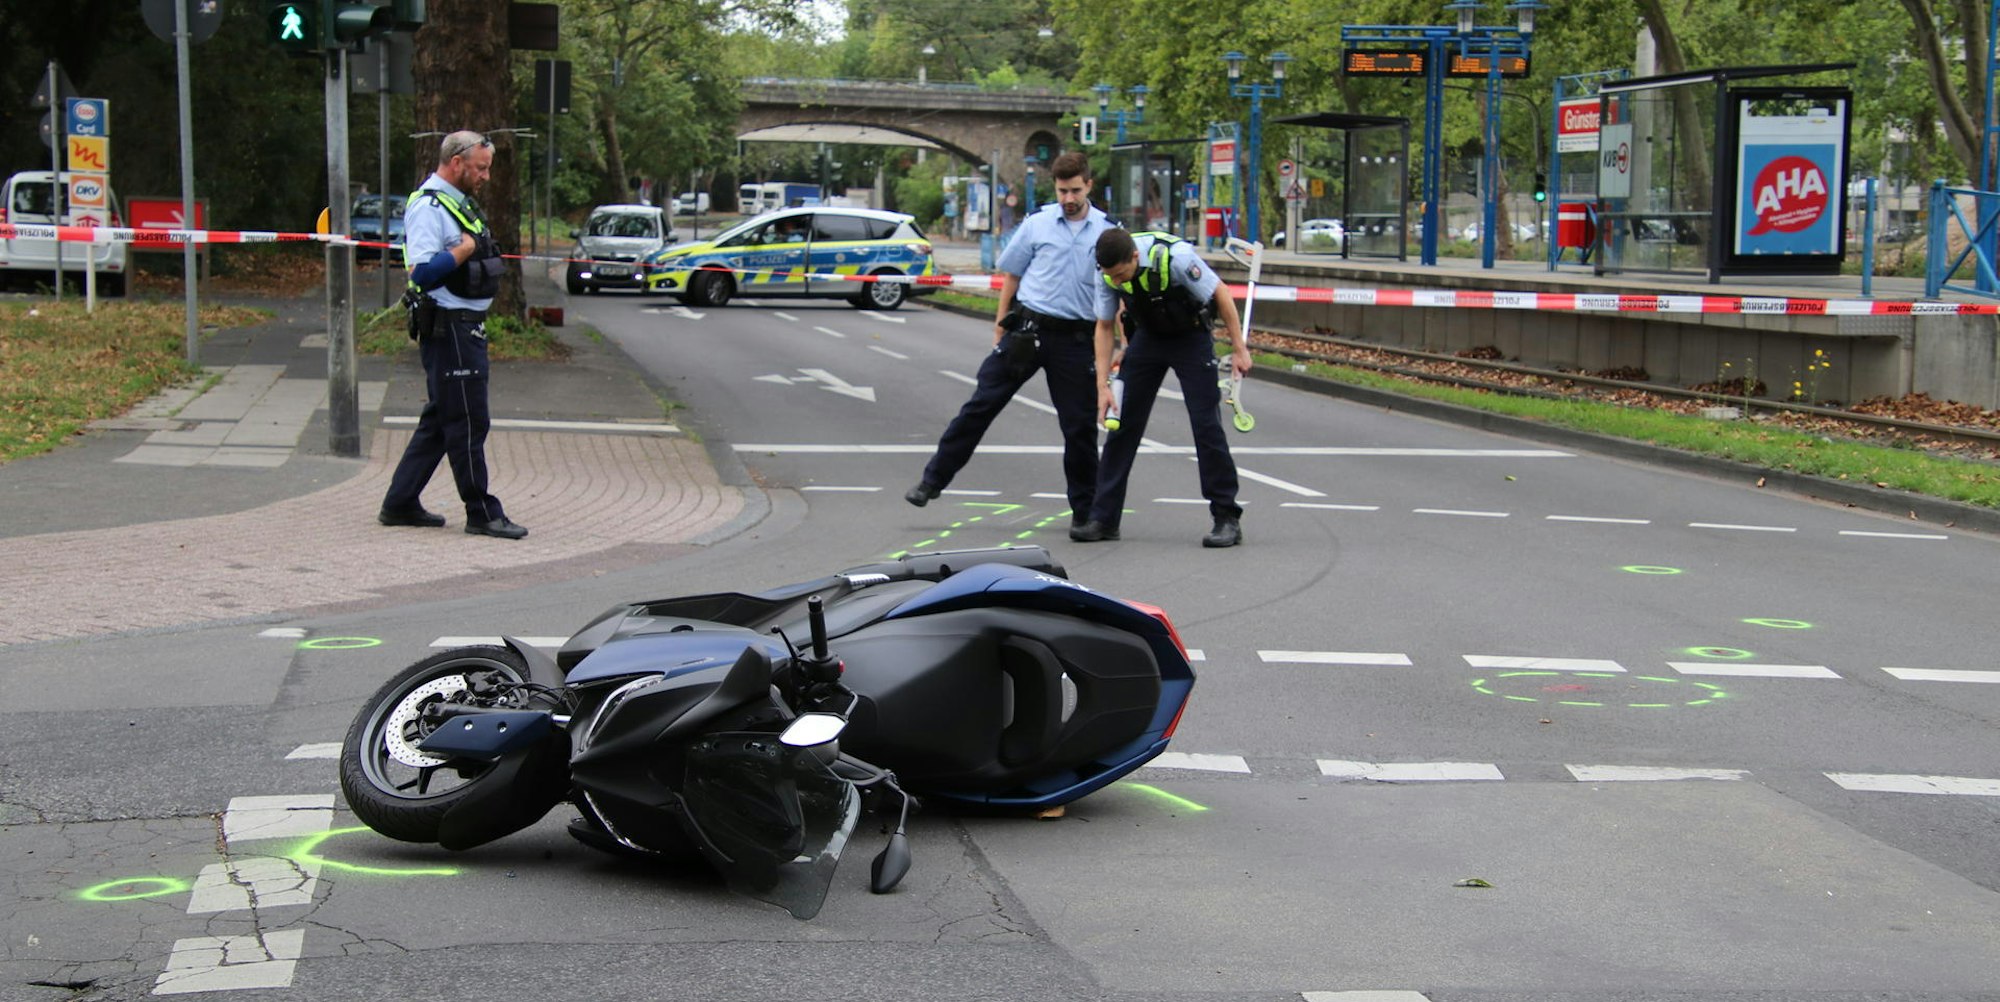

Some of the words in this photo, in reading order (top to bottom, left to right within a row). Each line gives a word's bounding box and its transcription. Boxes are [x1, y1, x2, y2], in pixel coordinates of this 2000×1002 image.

[76, 124, 95, 134] Card
[76, 186, 99, 196] DKV
[1755, 167, 1826, 216] AHA
[750, 254, 787, 264] POLIZEI
[1733, 301, 1823, 312] POLIZEIABSPERRUNG
